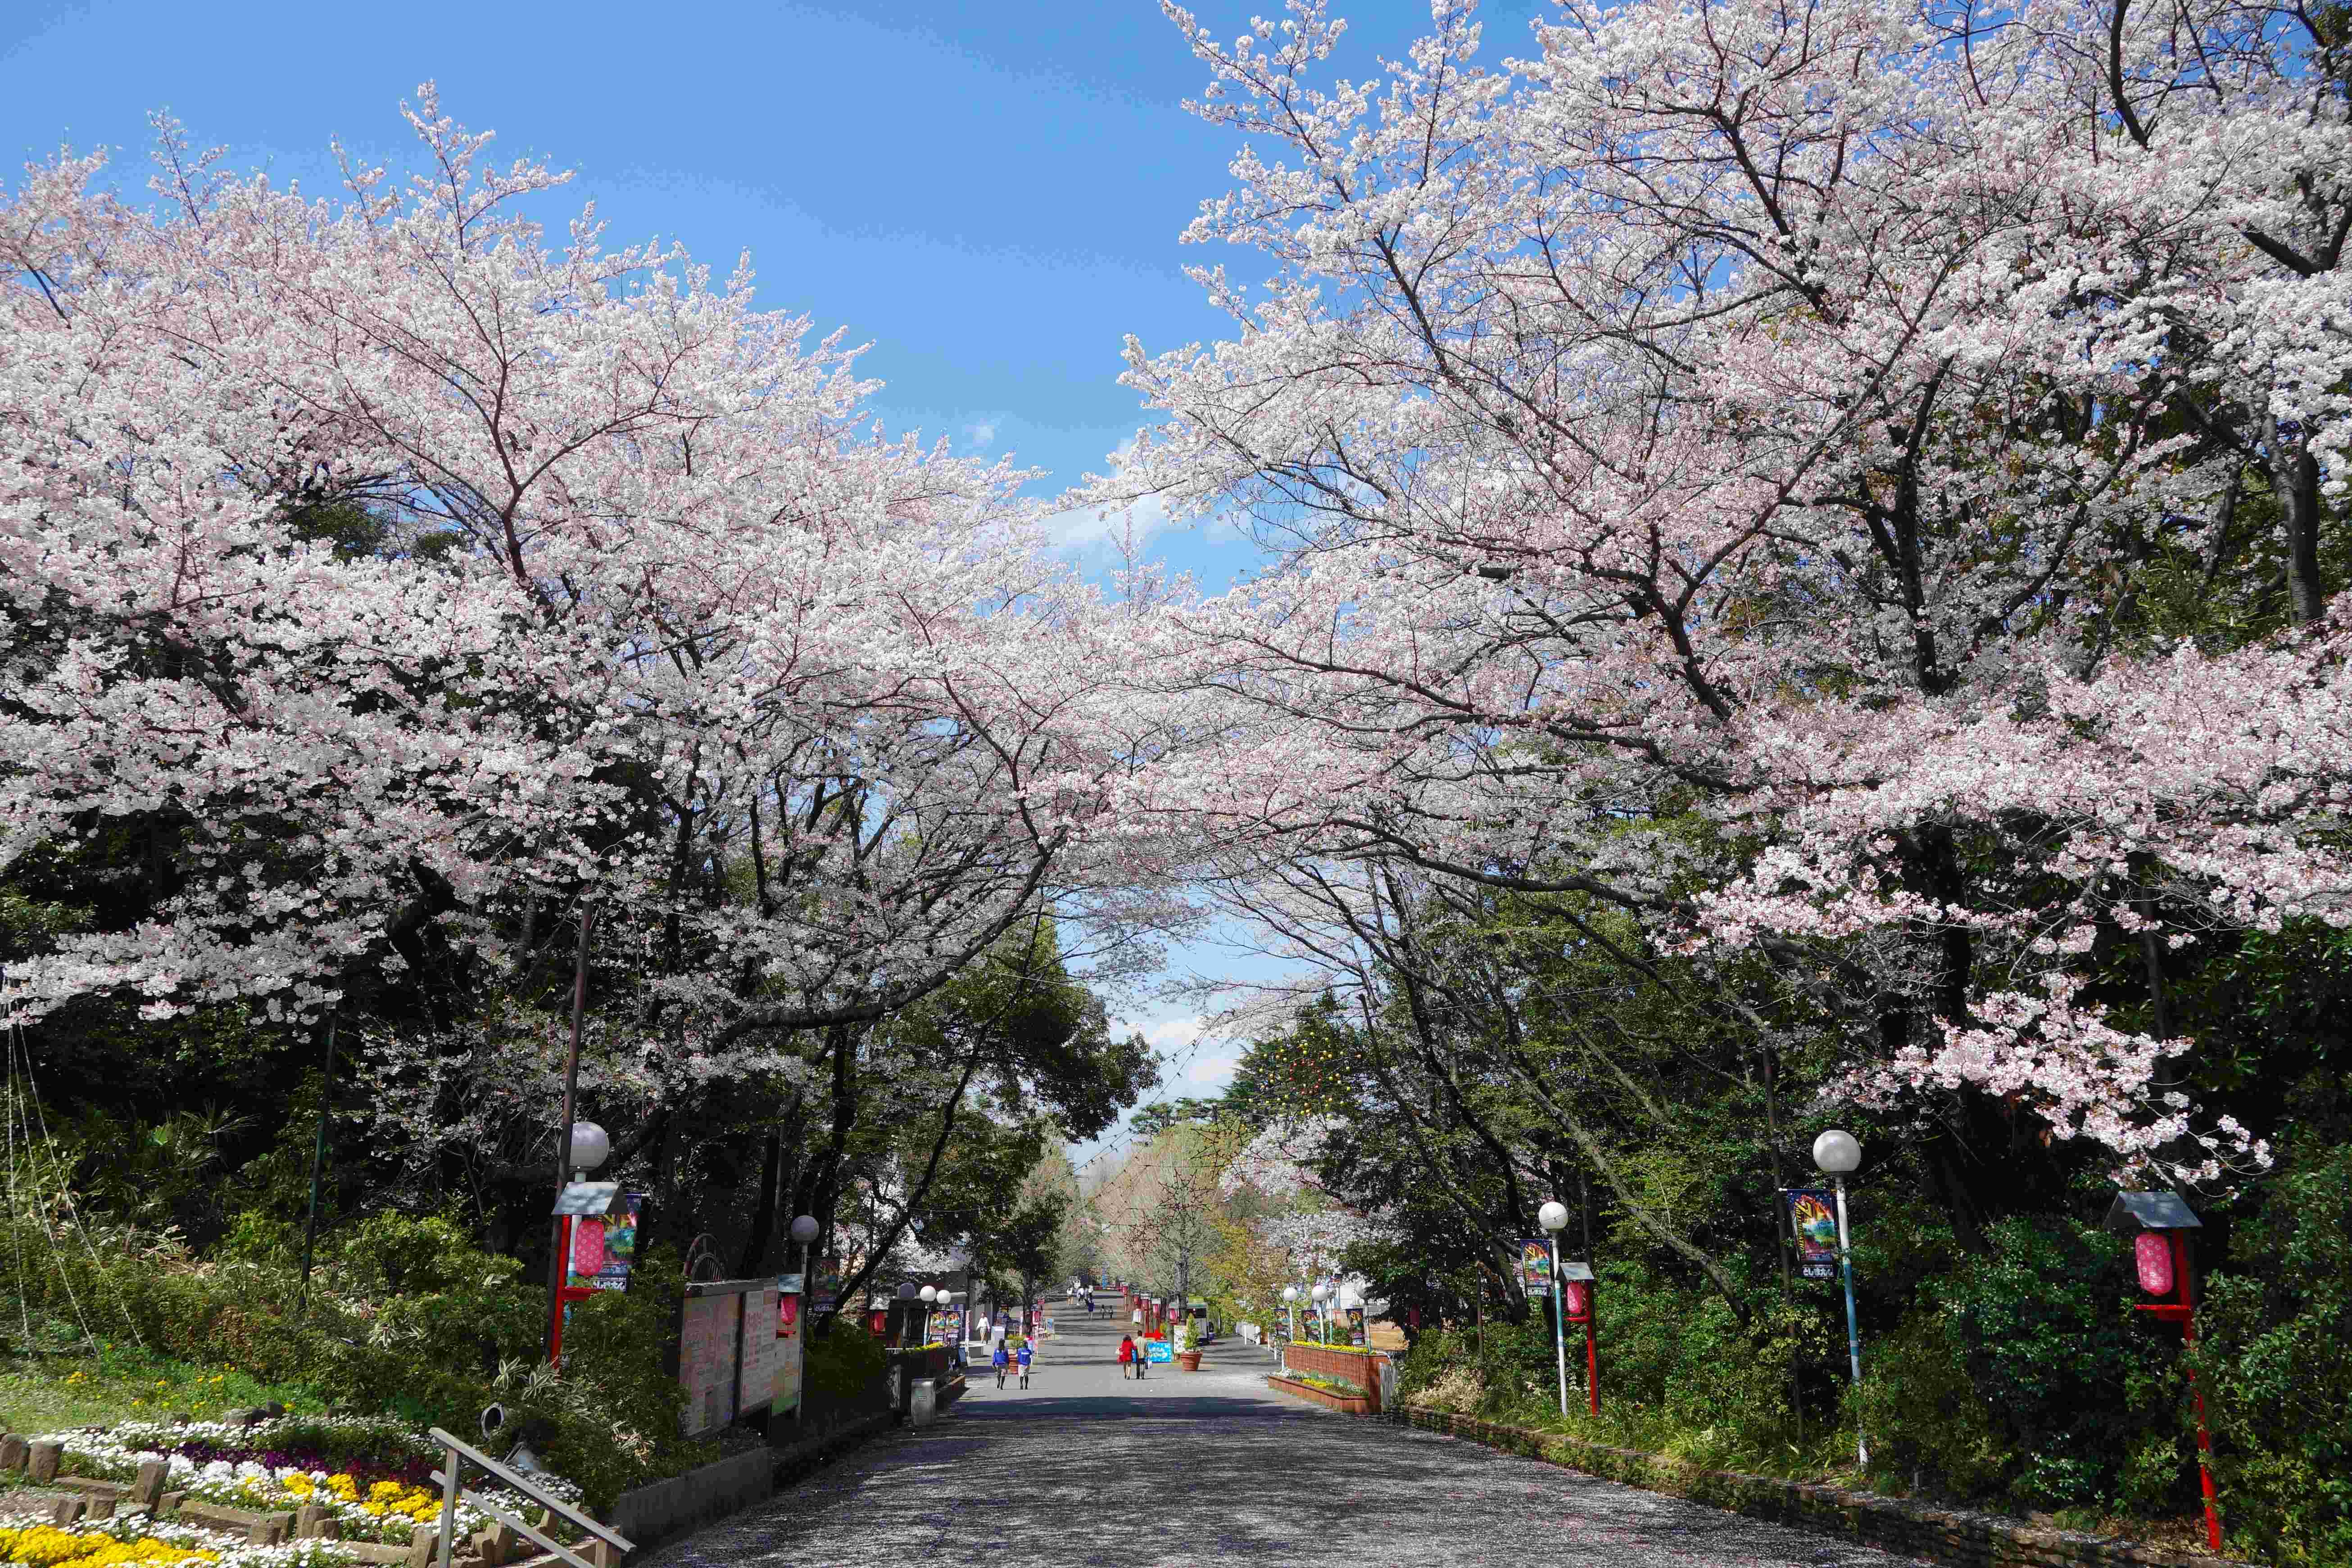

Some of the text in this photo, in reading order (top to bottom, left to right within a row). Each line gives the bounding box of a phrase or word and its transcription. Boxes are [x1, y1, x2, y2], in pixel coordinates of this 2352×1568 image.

[1803, 1268, 1834, 1276] としまえん
